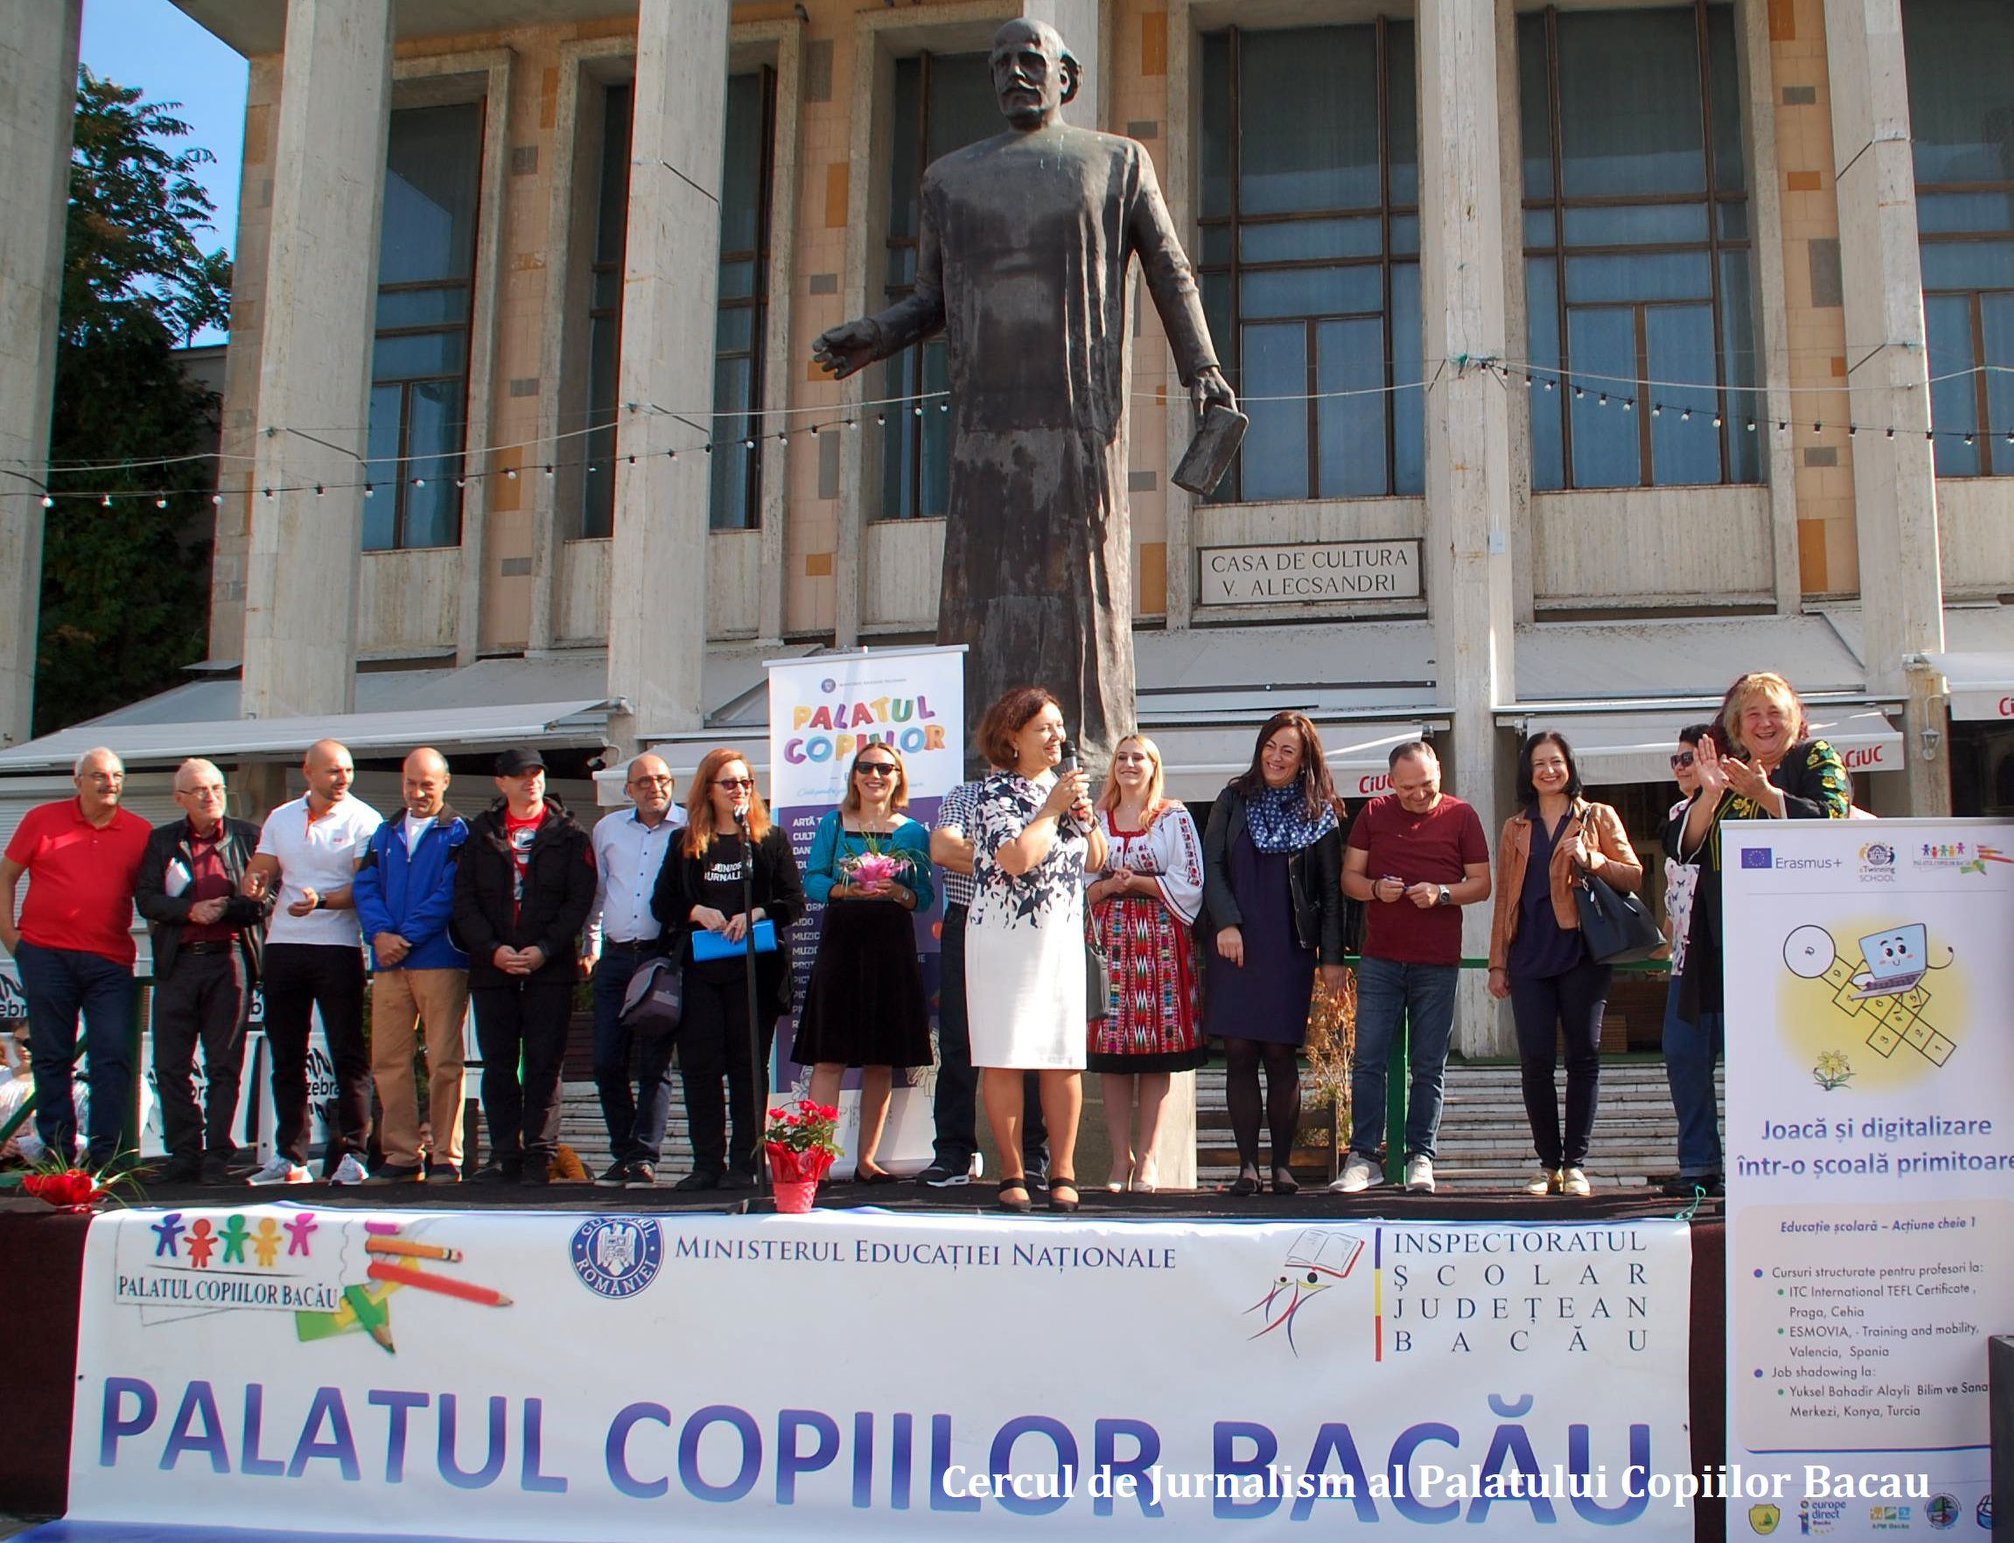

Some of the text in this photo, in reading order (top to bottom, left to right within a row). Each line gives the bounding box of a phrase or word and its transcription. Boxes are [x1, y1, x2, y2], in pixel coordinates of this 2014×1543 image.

[1211, 548, 1408, 573] CASA DE CULTURA
[1222, 574, 1395, 597] V. ALECSANDRI
[793, 695, 936, 730] PALATUL
[1845, 745, 1883, 768] CiUC
[793, 816, 815, 826] ARTĂ
[1776, 857, 1842, 869] Erasmus+
[1860, 875, 1895, 883] SCHOOL
[1762, 1115, 1993, 1143] Joacă și digitalizare
[1736, 1154, 1806, 1177] într-o
[1813, 1152, 1889, 1179] școală
[1781, 1220, 1830, 1236] Educație
[1834, 1219, 1878, 1235] școlară
[1892, 1217, 1934, 1234] Acțiune
[1938, 1216, 1966, 1229] cheie
[1971, 1216, 1976, 1228] 1
[1394, 1231, 1647, 1253] INSPECTORATUL
[1772, 1260, 1984, 1280] Cursuri structurate pentru profesori la:
[118, 1276, 338, 1308] PALATUL COPIILOR BACĂU
[1789, 1286, 1808, 1297] ITC
[1811, 1284, 1883, 1297] International
[1887, 1285, 1913, 1296] TEFL
[1916, 1282, 1970, 1296] Certificate
[1789, 1306, 1864, 1320] Praga, Cehia
[1789, 1326, 1852, 1339] ESMOVIA,
[1863, 1324, 1908, 1339] Training
[1911, 1323, 1932, 1336] and
[1790, 1346, 1890, 1359] Valencia, Spania
[1772, 1365, 1876, 1380] Job shadowing la:
[1790, 1385, 1825, 1397] Yuksel
[1828, 1384, 1872, 1397] Bahadir
[1877, 1384, 1911, 1399] Alayli
[1917, 1384, 1943, 1396] Bilim
[1946, 1386, 1958, 1394] ve
[1790, 1405, 1921, 1419] Merkezi, Konya, Turcia
[100, 1376, 1651, 1526] PALATUL COPIILOR BACĂU
[1811, 1501, 1846, 1510] europe
[1811, 1509, 1840, 1519] direct
